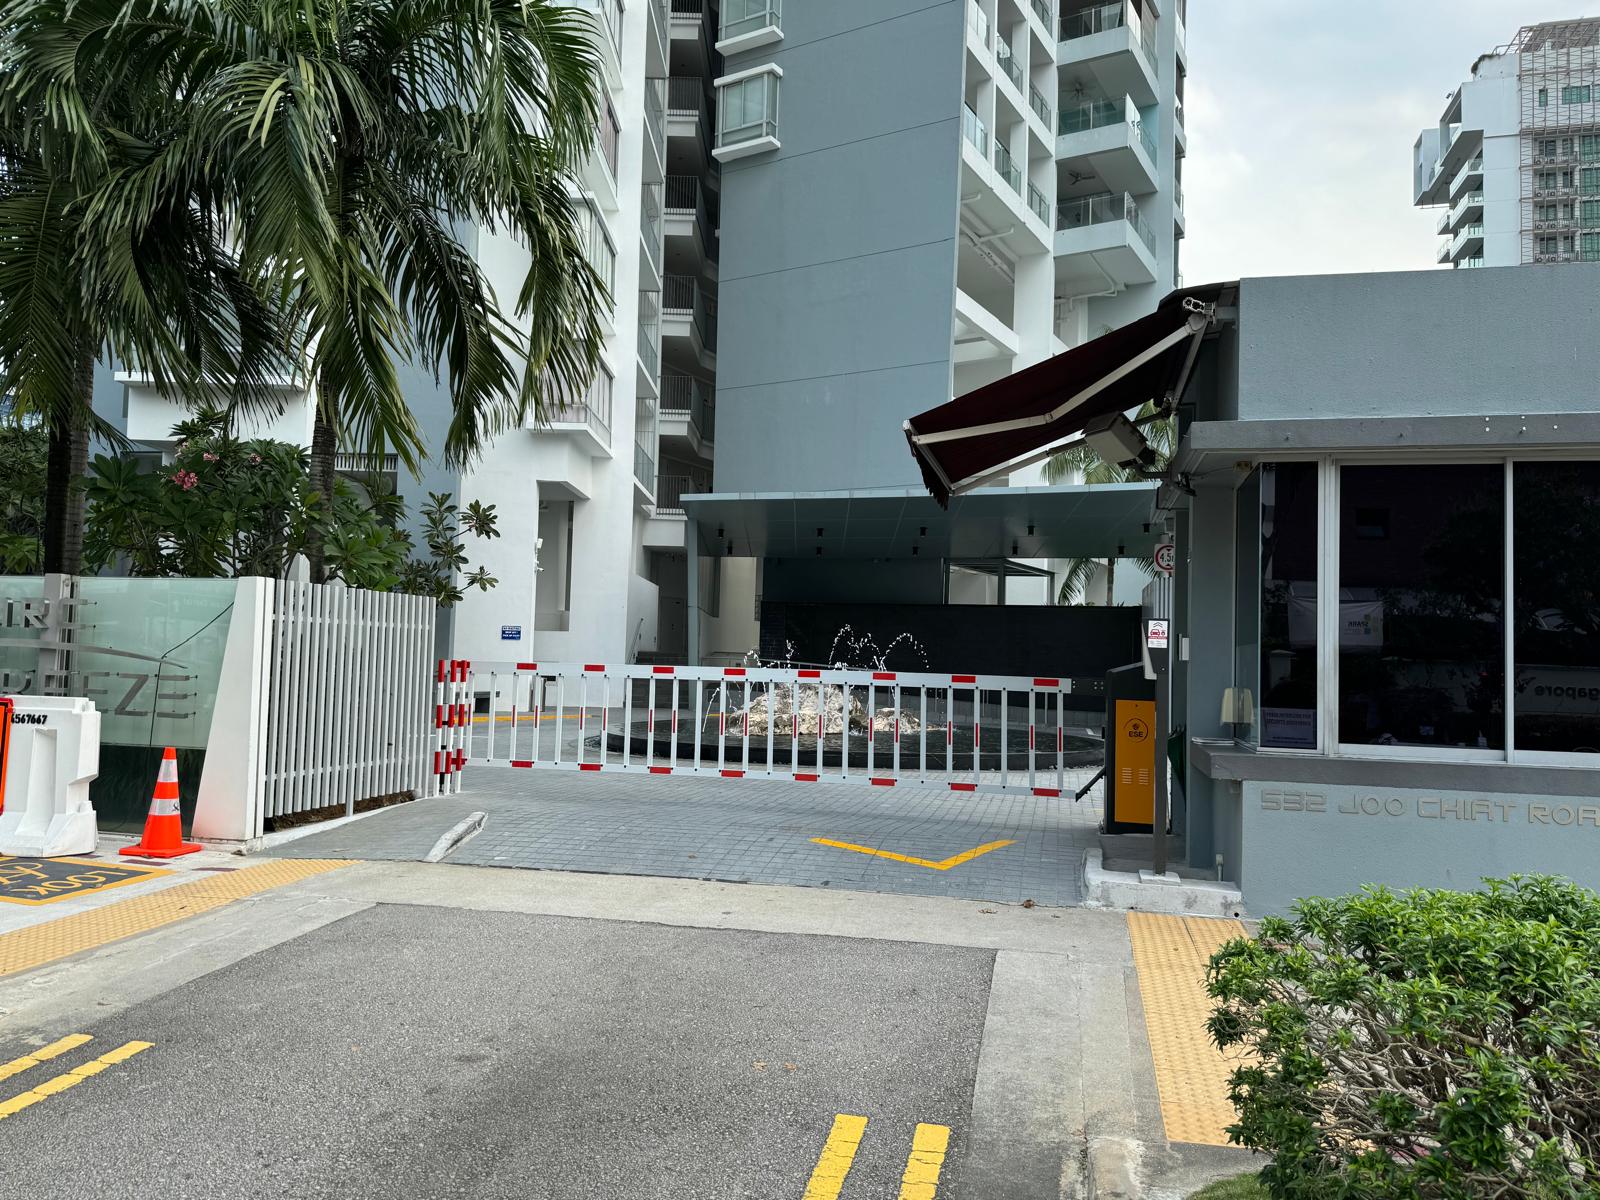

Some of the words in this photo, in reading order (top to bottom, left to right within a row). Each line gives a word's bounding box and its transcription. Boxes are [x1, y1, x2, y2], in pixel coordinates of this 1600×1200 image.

[1128, 730, 1144, 738] ESE
[1338, 793, 1406, 817] JOO
[1417, 797, 1517, 823] CHIAT
[1528, 802, 1600, 827] ROA
[10, 869, 129, 896] LOOK
